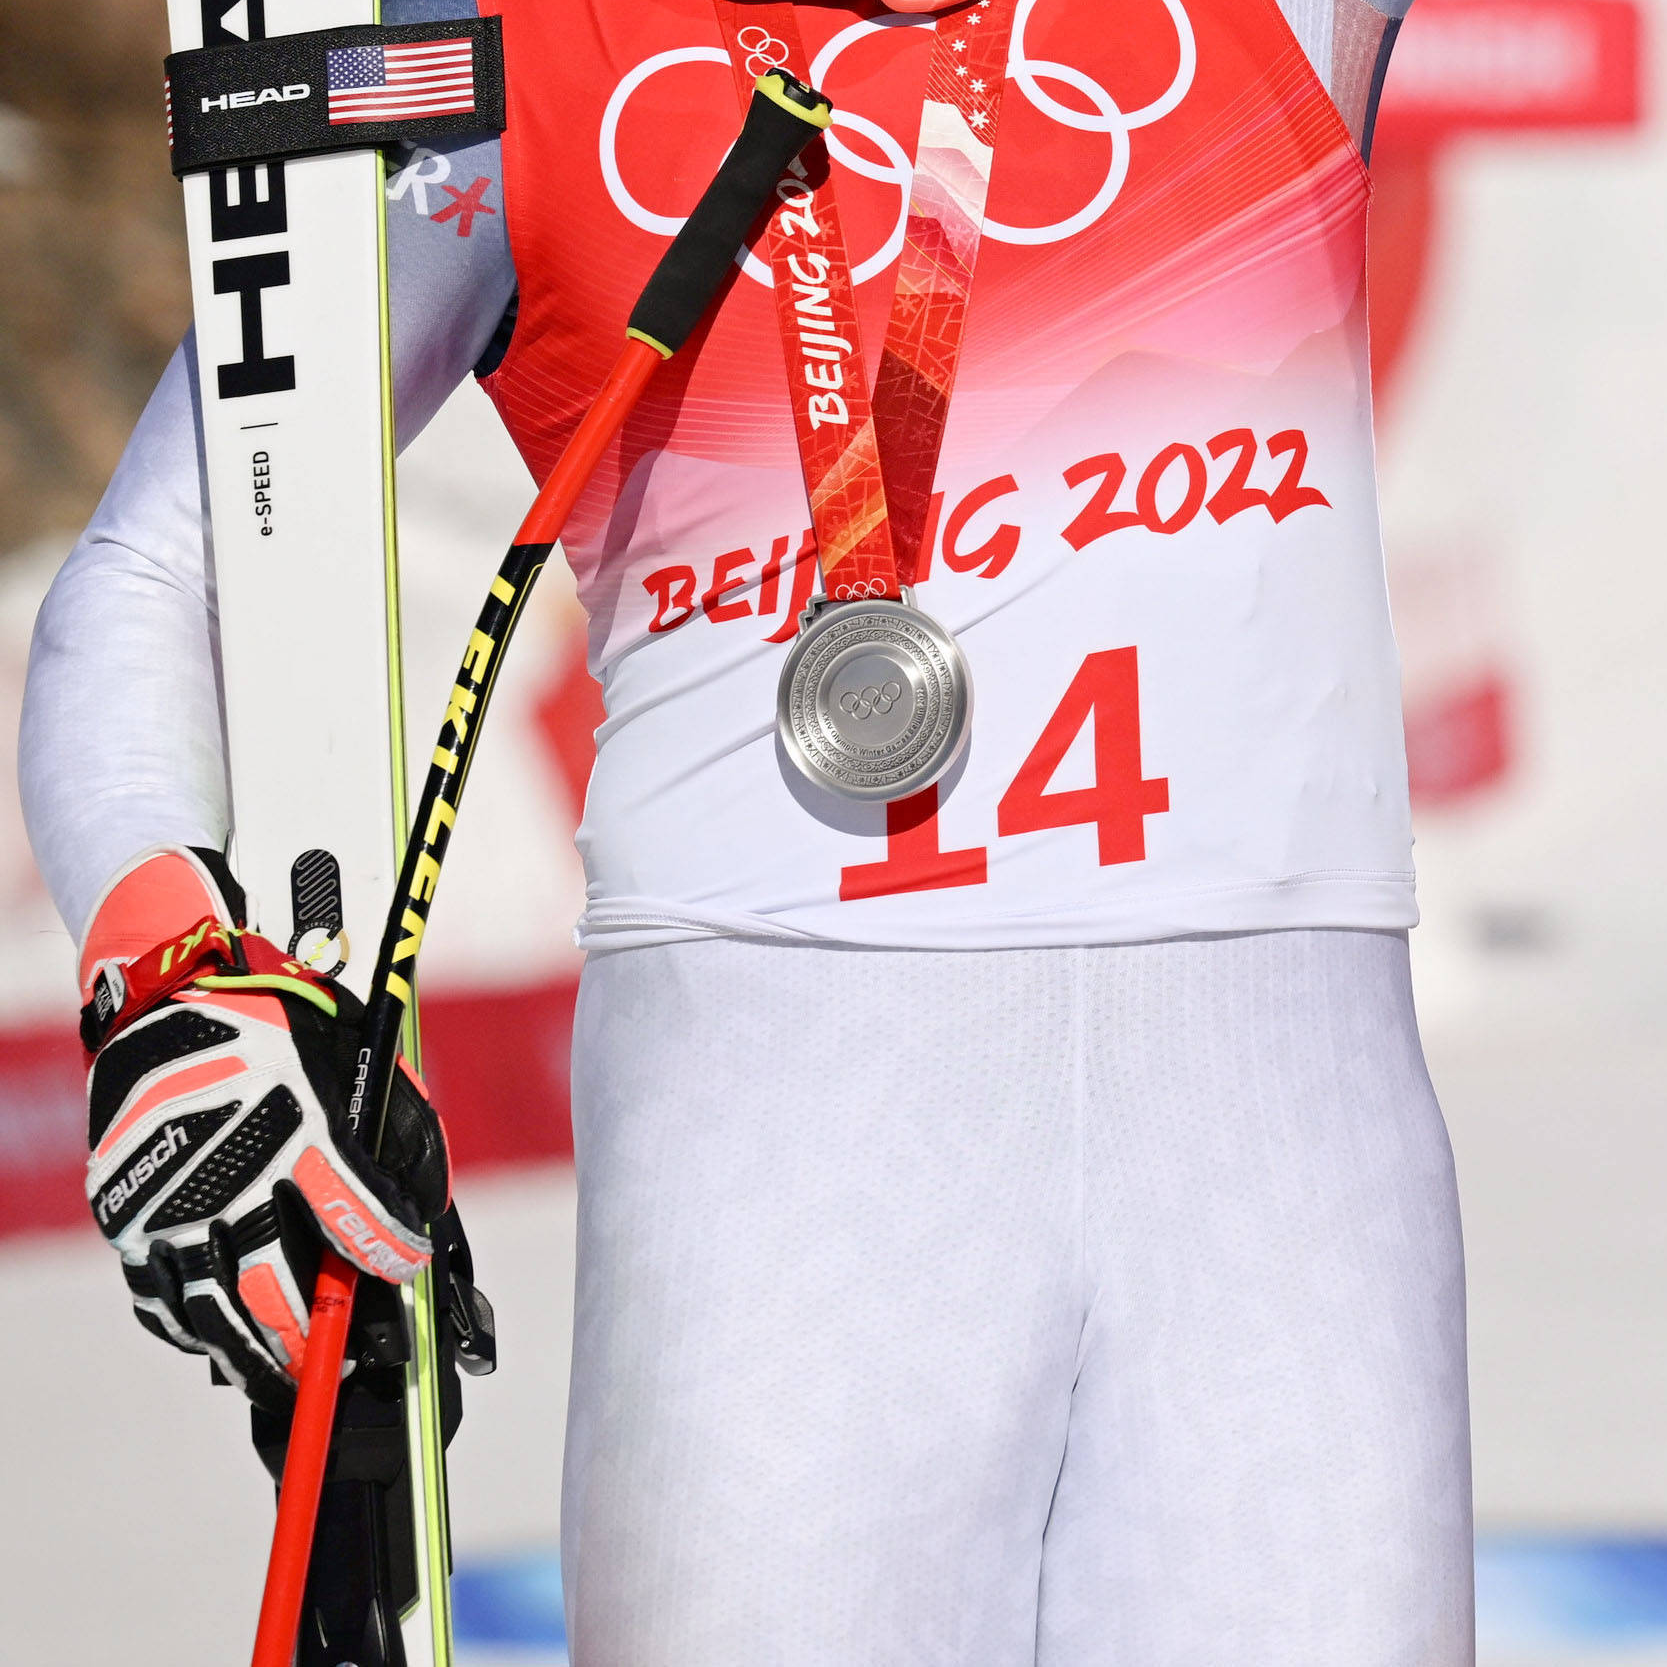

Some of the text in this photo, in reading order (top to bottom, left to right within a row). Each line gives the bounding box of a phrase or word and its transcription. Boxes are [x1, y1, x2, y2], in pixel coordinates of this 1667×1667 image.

[201, 84, 310, 113] HEAD
[787, 252, 853, 431] BEIJING
[253, 450, 274, 536] e-SPEED
[1060, 429, 1333, 551] 2022
[98, 1124, 189, 1225] reusch
